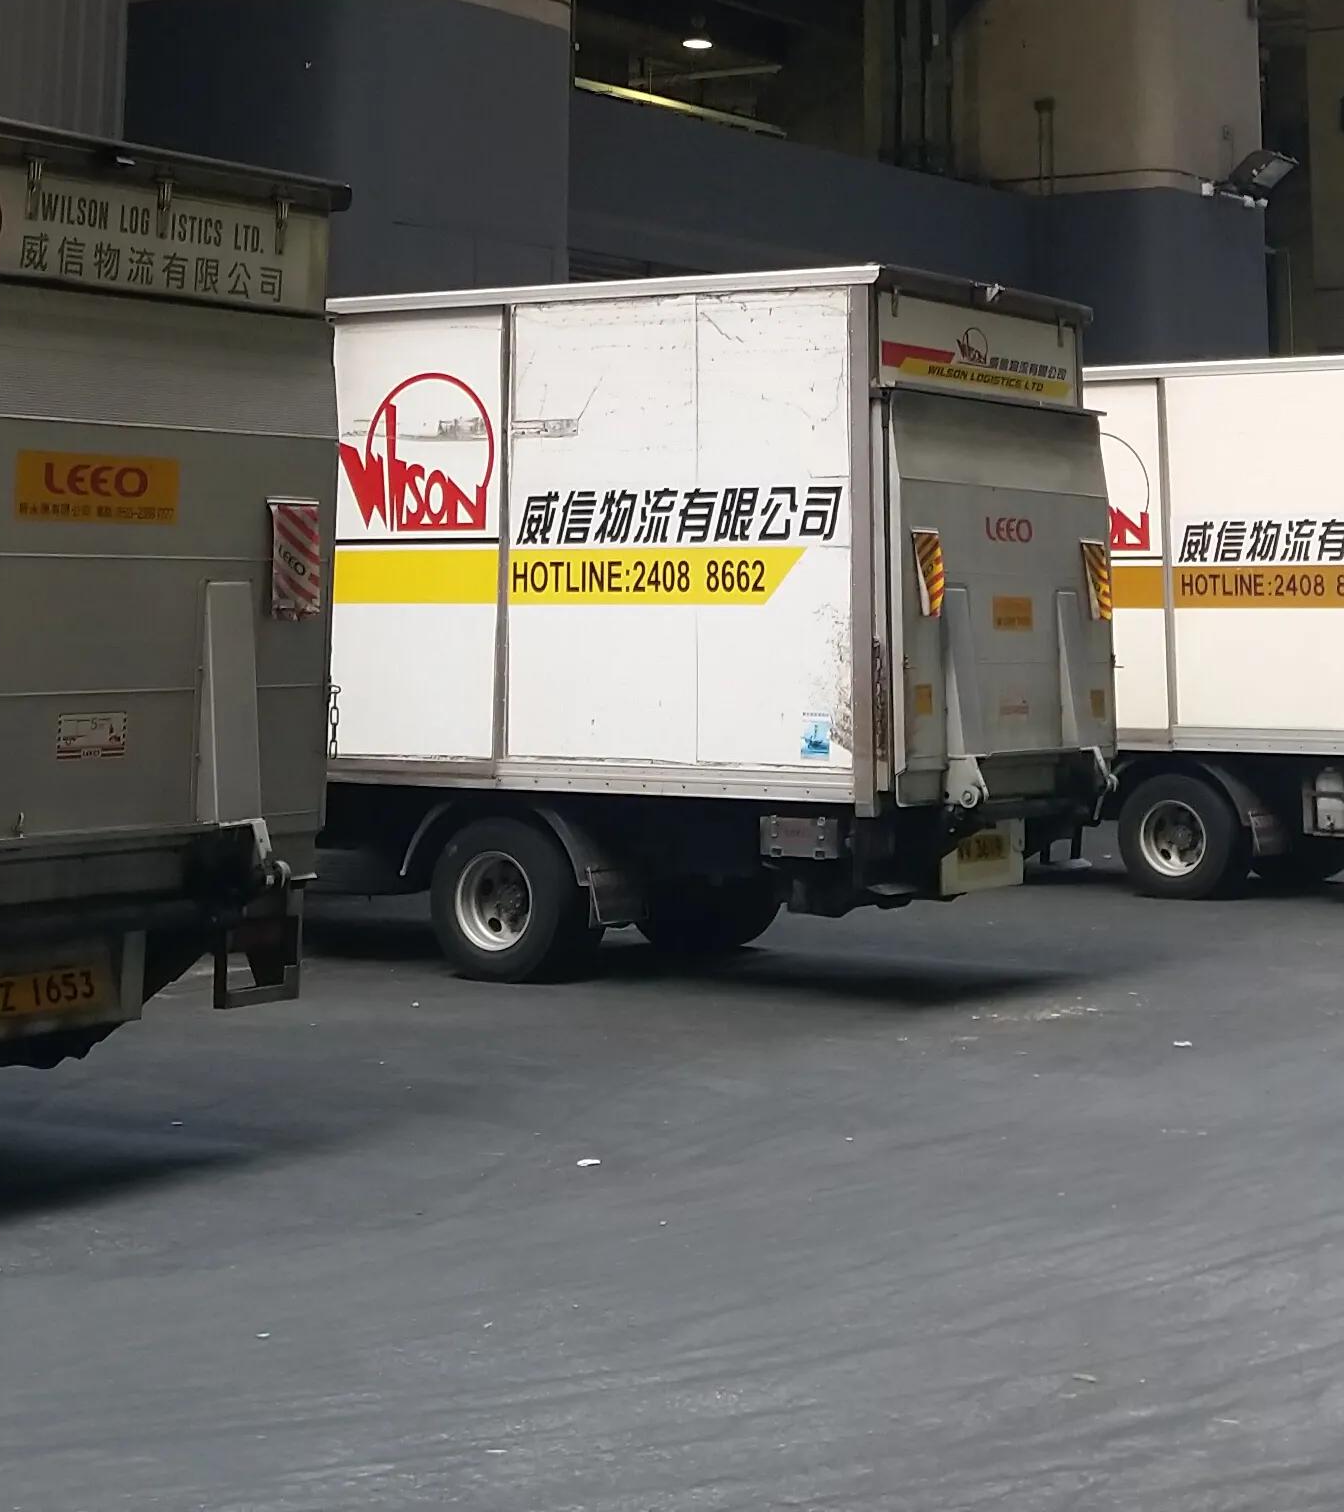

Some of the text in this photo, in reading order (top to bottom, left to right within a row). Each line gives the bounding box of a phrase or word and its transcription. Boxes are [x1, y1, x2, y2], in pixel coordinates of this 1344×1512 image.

[39, 191, 265, 254] WILSON LOGISTICS LTD.
[20, 235, 283, 303] 威信物流有限公司
[928, 365, 968, 380] WILSON
[970, 371, 1022, 389] LOGISTICS
[44, 462, 149, 499] LEEO
[516, 486, 843, 544] 威信物流有限公司
[985, 517, 1033, 543] LEEO
[706, 560, 766, 593] 8662
[31, 969, 96, 1007] 1653
